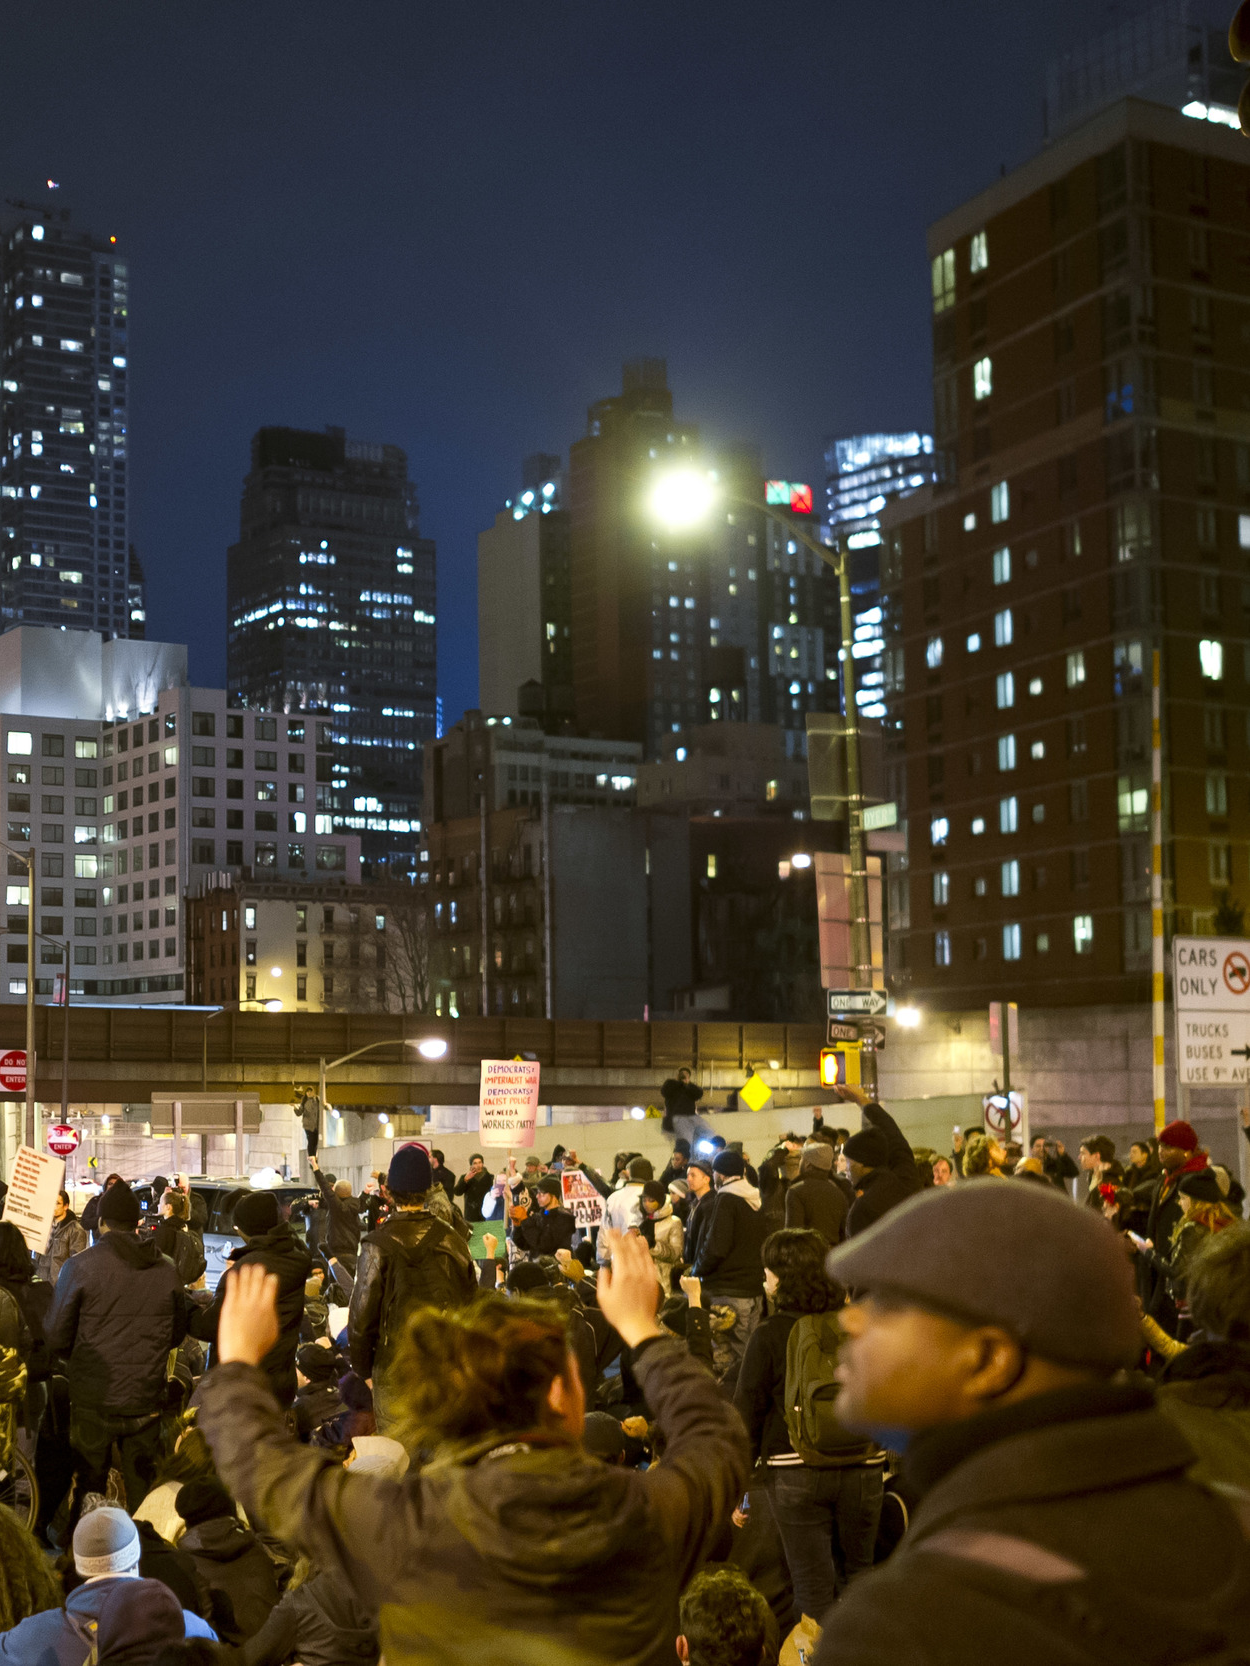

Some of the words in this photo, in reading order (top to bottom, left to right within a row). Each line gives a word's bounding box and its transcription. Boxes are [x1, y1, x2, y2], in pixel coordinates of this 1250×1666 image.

[864, 808, 888, 826] DYER
[1178, 948, 1217, 966] CARS
[1180, 977, 1217, 995] ONLY
[862, 998, 879, 1007] WAY
[1186, 1023, 1229, 1038] TRUCKS
[1186, 1045, 1222, 1059] BUSES
[1187, 1067, 1209, 1081] USE
[485, 1076, 522, 1084] IMPERIALIST
[525, 1076, 537, 1084] WAR
[483, 1098, 506, 1106] RACIST
[510, 1097, 531, 1105] POLICE
[482, 1120, 514, 1129] WORKERS
[570, 1200, 600, 1209] JAIL
[575, 1208, 602, 1217] ILLER
